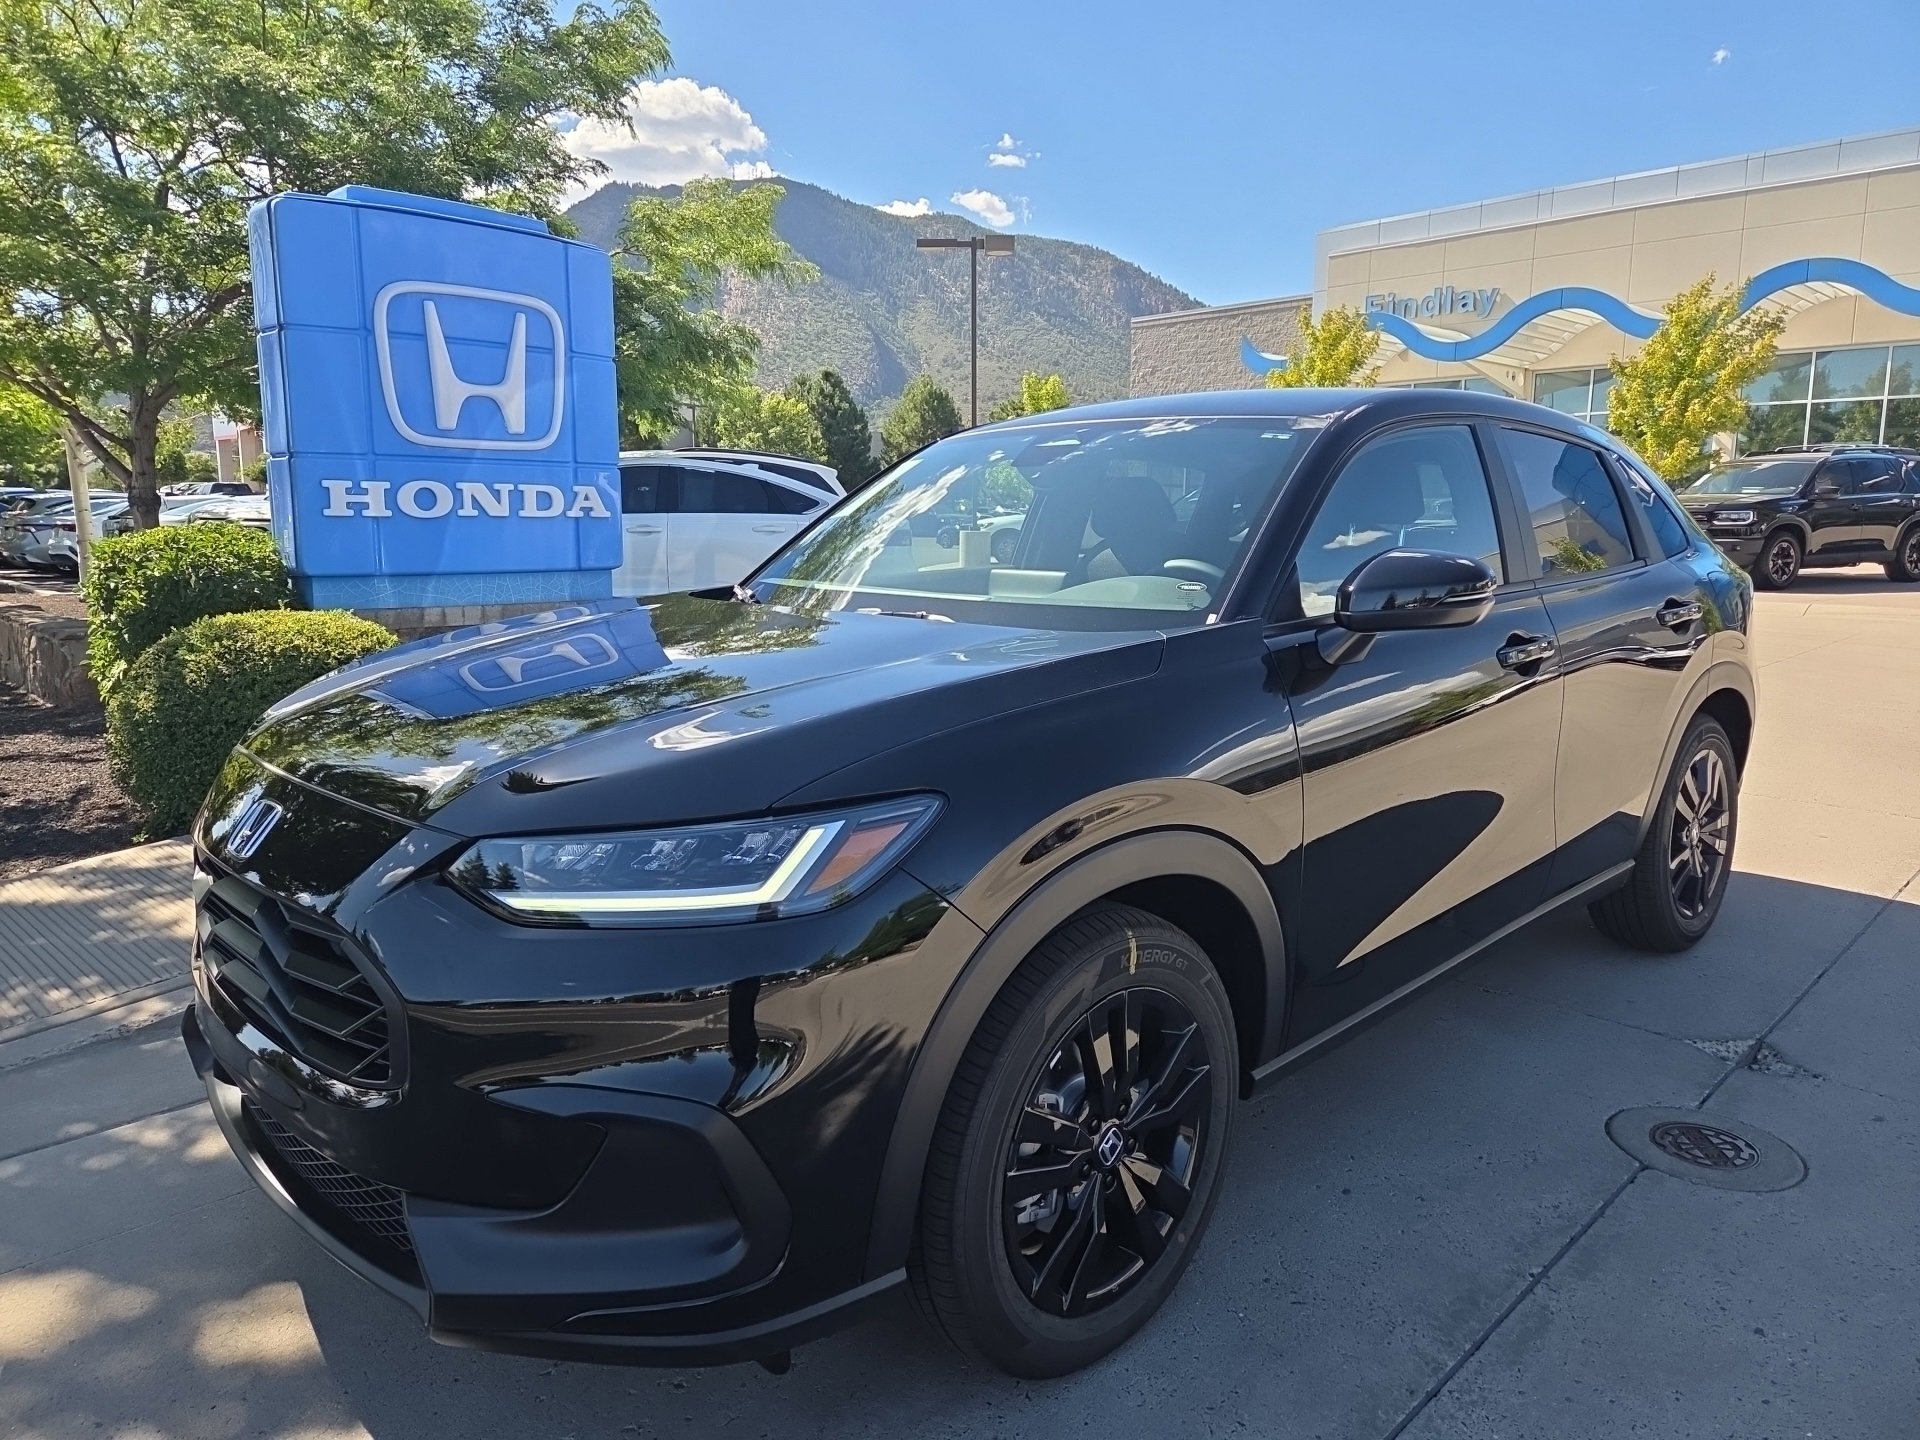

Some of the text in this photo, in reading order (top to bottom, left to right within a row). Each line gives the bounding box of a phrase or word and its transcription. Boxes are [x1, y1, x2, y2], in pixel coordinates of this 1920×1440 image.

[1365, 286, 1500, 319] Findlay
[321, 479, 612, 519] HONDA
[1121, 949, 1189, 971] KNERGY GT
